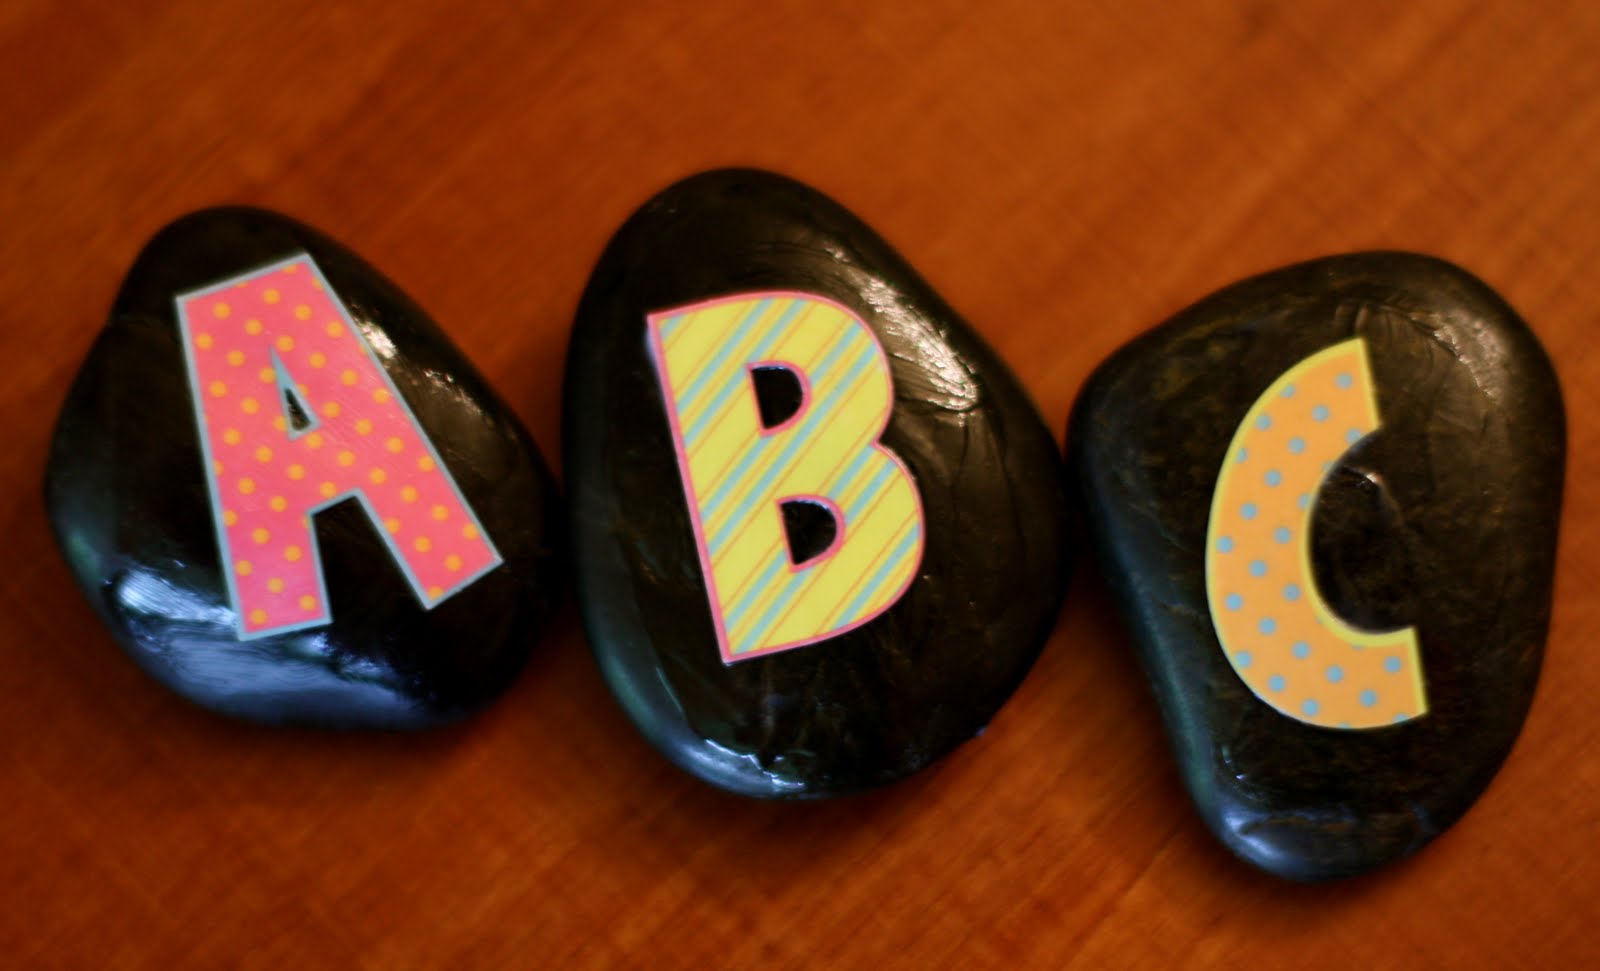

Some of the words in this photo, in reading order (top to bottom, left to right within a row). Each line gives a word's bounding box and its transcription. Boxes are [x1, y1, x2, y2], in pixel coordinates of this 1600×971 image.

[175, 252, 503, 641] A
[646, 290, 926, 666] B
[1205, 337, 1428, 730] C
